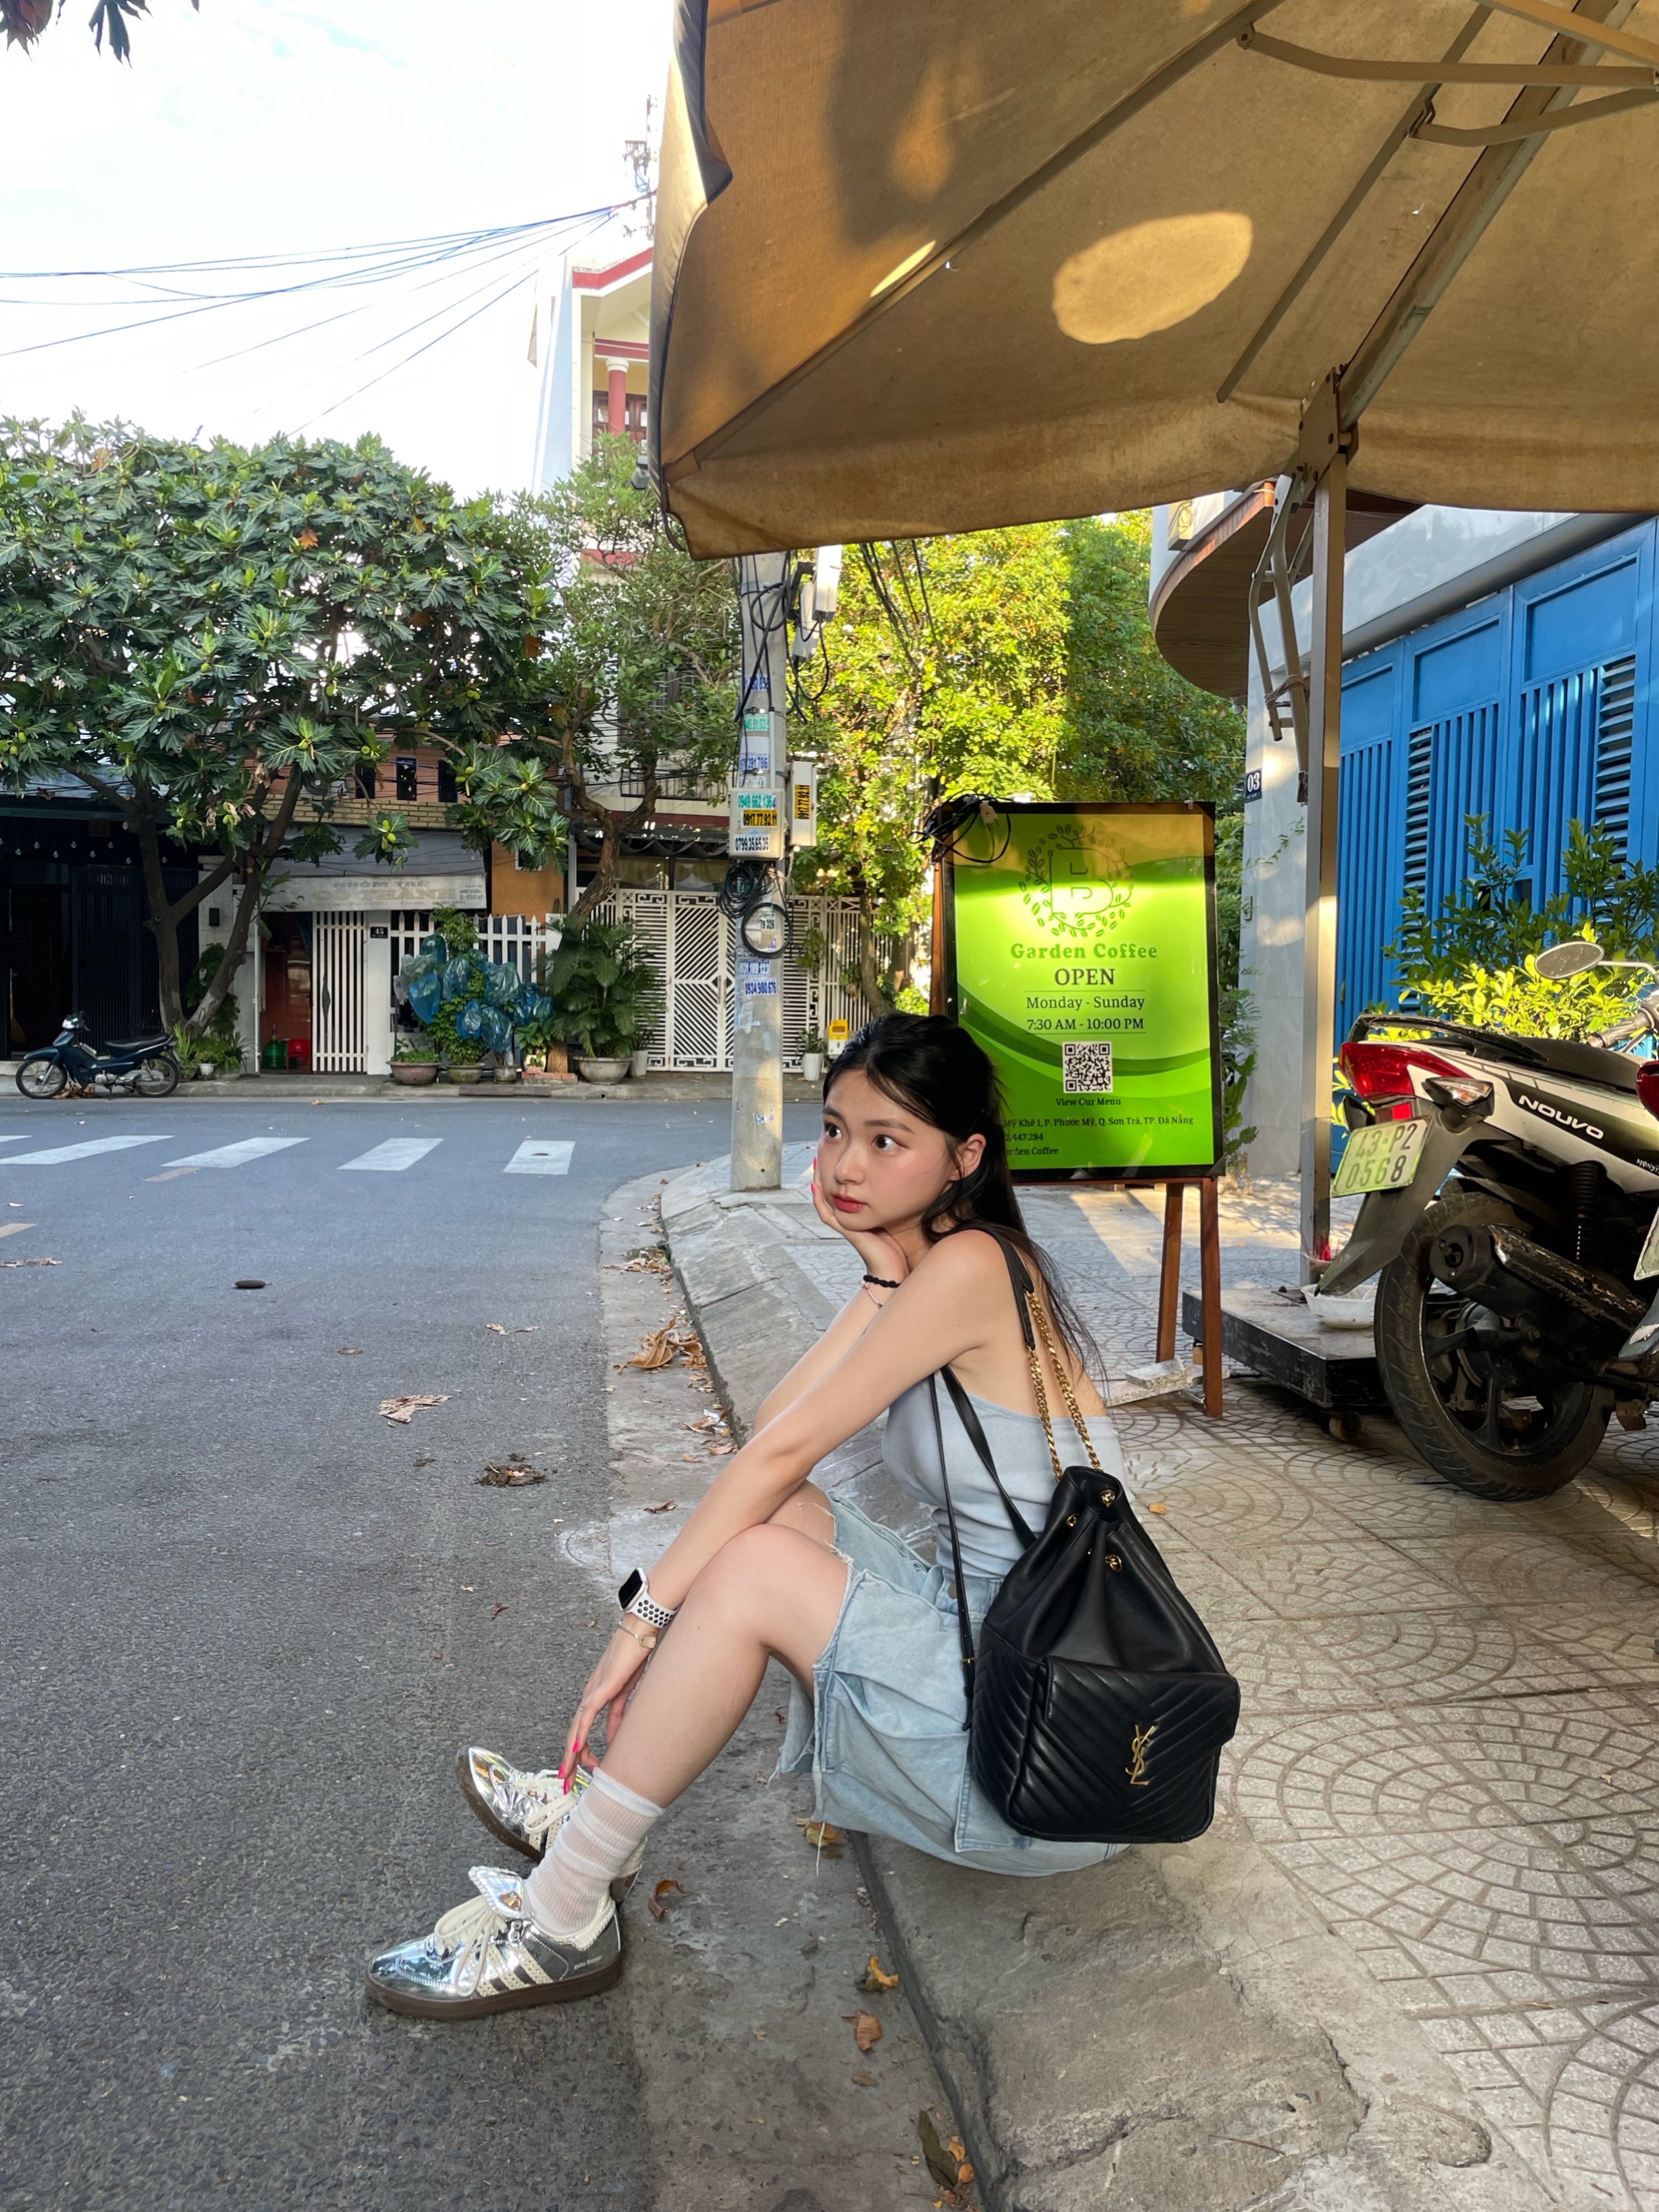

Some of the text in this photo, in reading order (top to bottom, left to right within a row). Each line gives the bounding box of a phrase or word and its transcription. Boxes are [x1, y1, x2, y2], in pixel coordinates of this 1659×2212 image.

[1248, 772, 1260, 792] 03
[1010, 943, 1157, 959] Garden Coffee
[1055, 968, 1115, 986] OPEN
[1026, 997, 1083, 1011] Monday
[1093, 996, 1145, 1010] Sunday
[1027, 1019, 1052, 1030] 7:30
[1055, 1019, 1076, 1029] AM
[1087, 1018, 1121, 1029] 10:00
[1124, 1018, 1144, 1029] PM
[1158, 1116, 1169, 1124] Đà
[1519, 1095, 1604, 1139] NOUVO
[1005, 1133, 1044, 1141] 2.447.284
[1356, 1123, 1417, 1158] 43-P2
[1345, 1155, 1406, 1189] 0568
